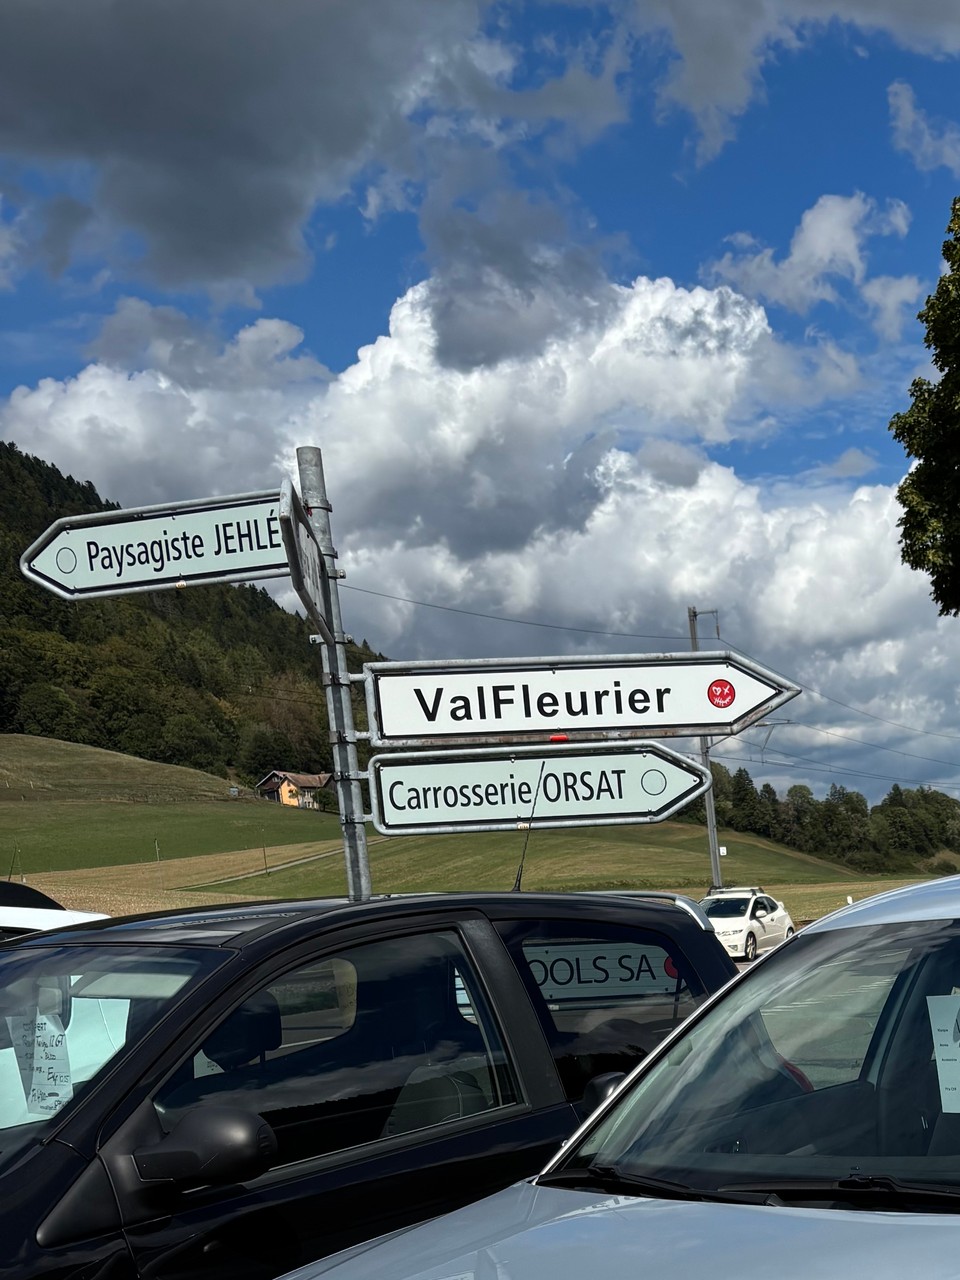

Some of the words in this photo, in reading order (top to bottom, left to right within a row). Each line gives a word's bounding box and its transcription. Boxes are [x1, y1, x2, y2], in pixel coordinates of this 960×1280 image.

[86, 529, 205, 578] Paysagiste
[213, 509, 282, 556] JEHLÉ
[413, 680, 672, 722] ValFleurier
[388, 773, 532, 811] Carrosserie
[543, 769, 627, 804] ORSAT
[617, 954, 656, 983] SA
